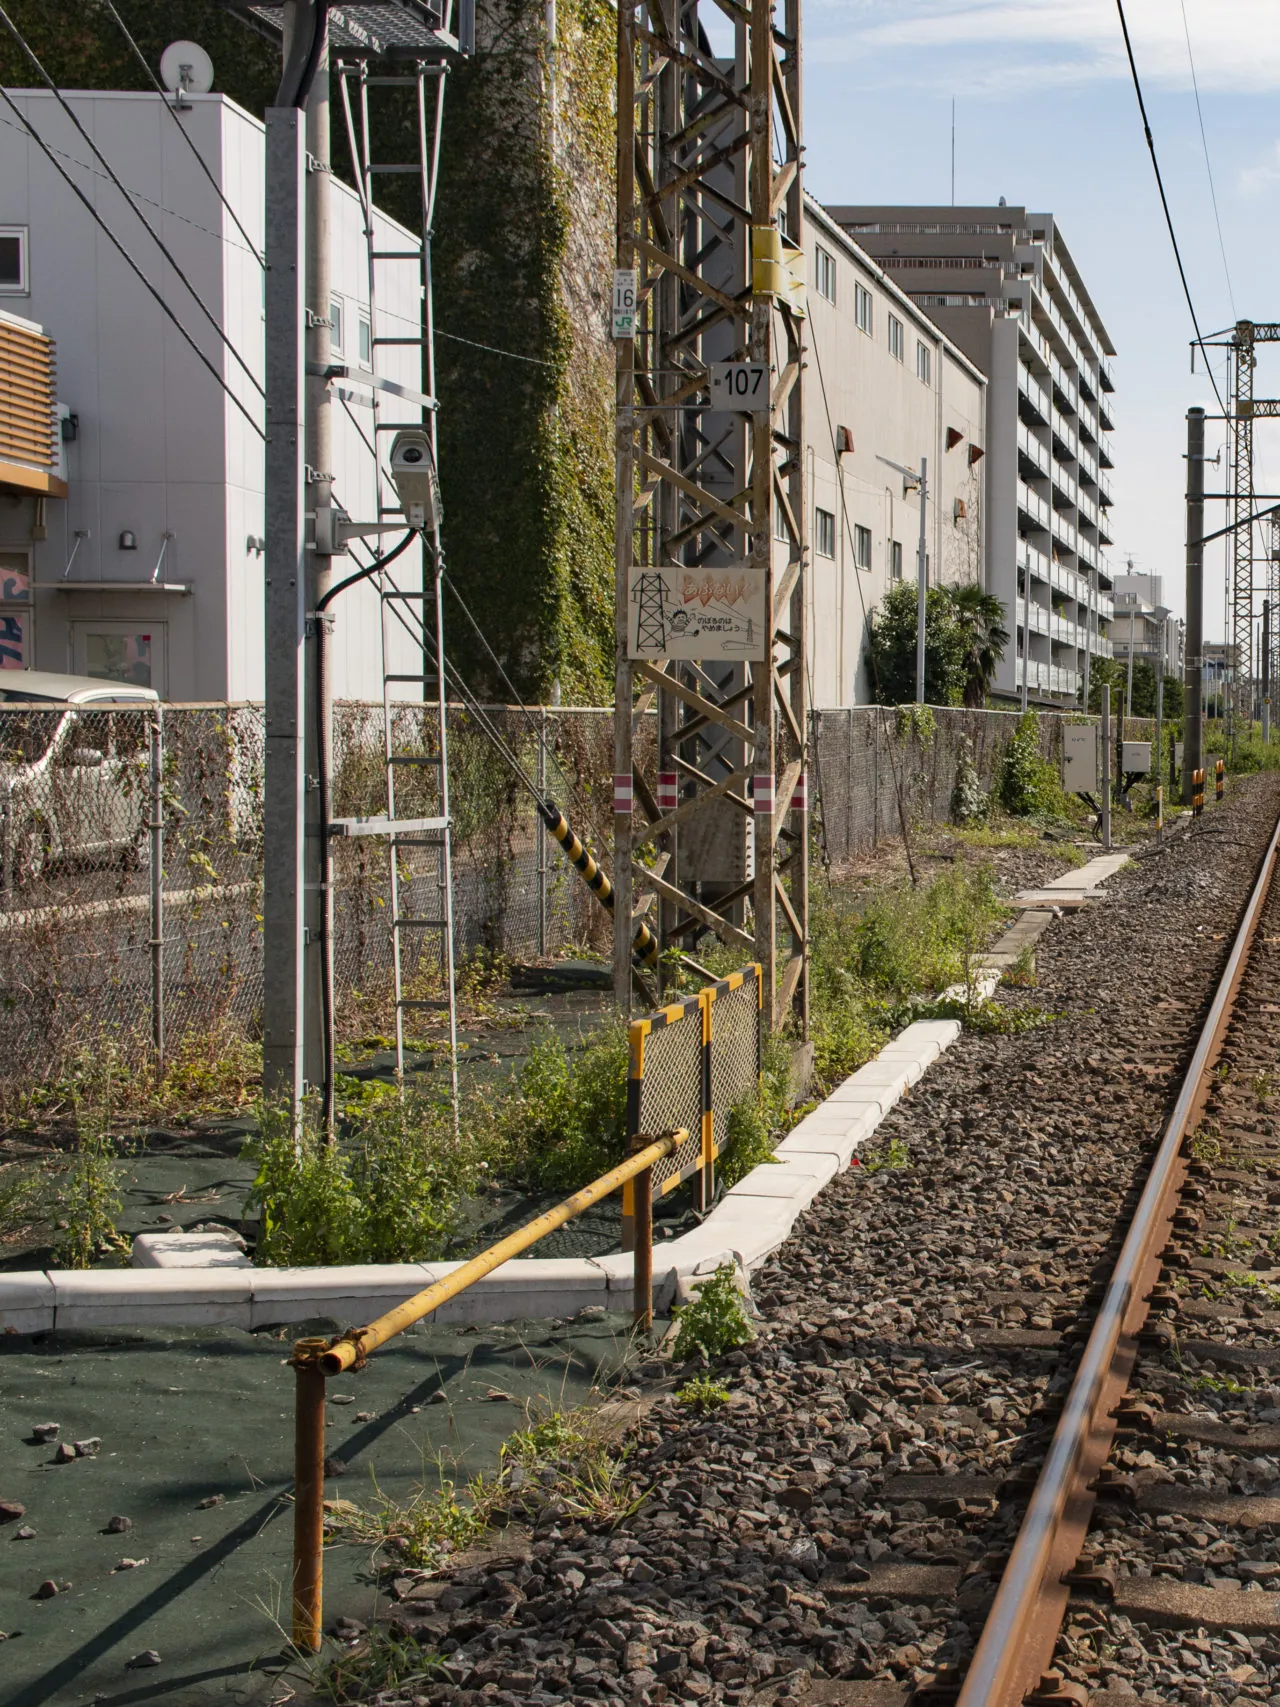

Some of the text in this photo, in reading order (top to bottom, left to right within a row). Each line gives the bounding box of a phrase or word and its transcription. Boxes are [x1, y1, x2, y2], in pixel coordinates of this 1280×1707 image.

[617, 289, 633, 307] 16
[615, 316, 632, 327] JR
[724, 369, 763, 395] 107
